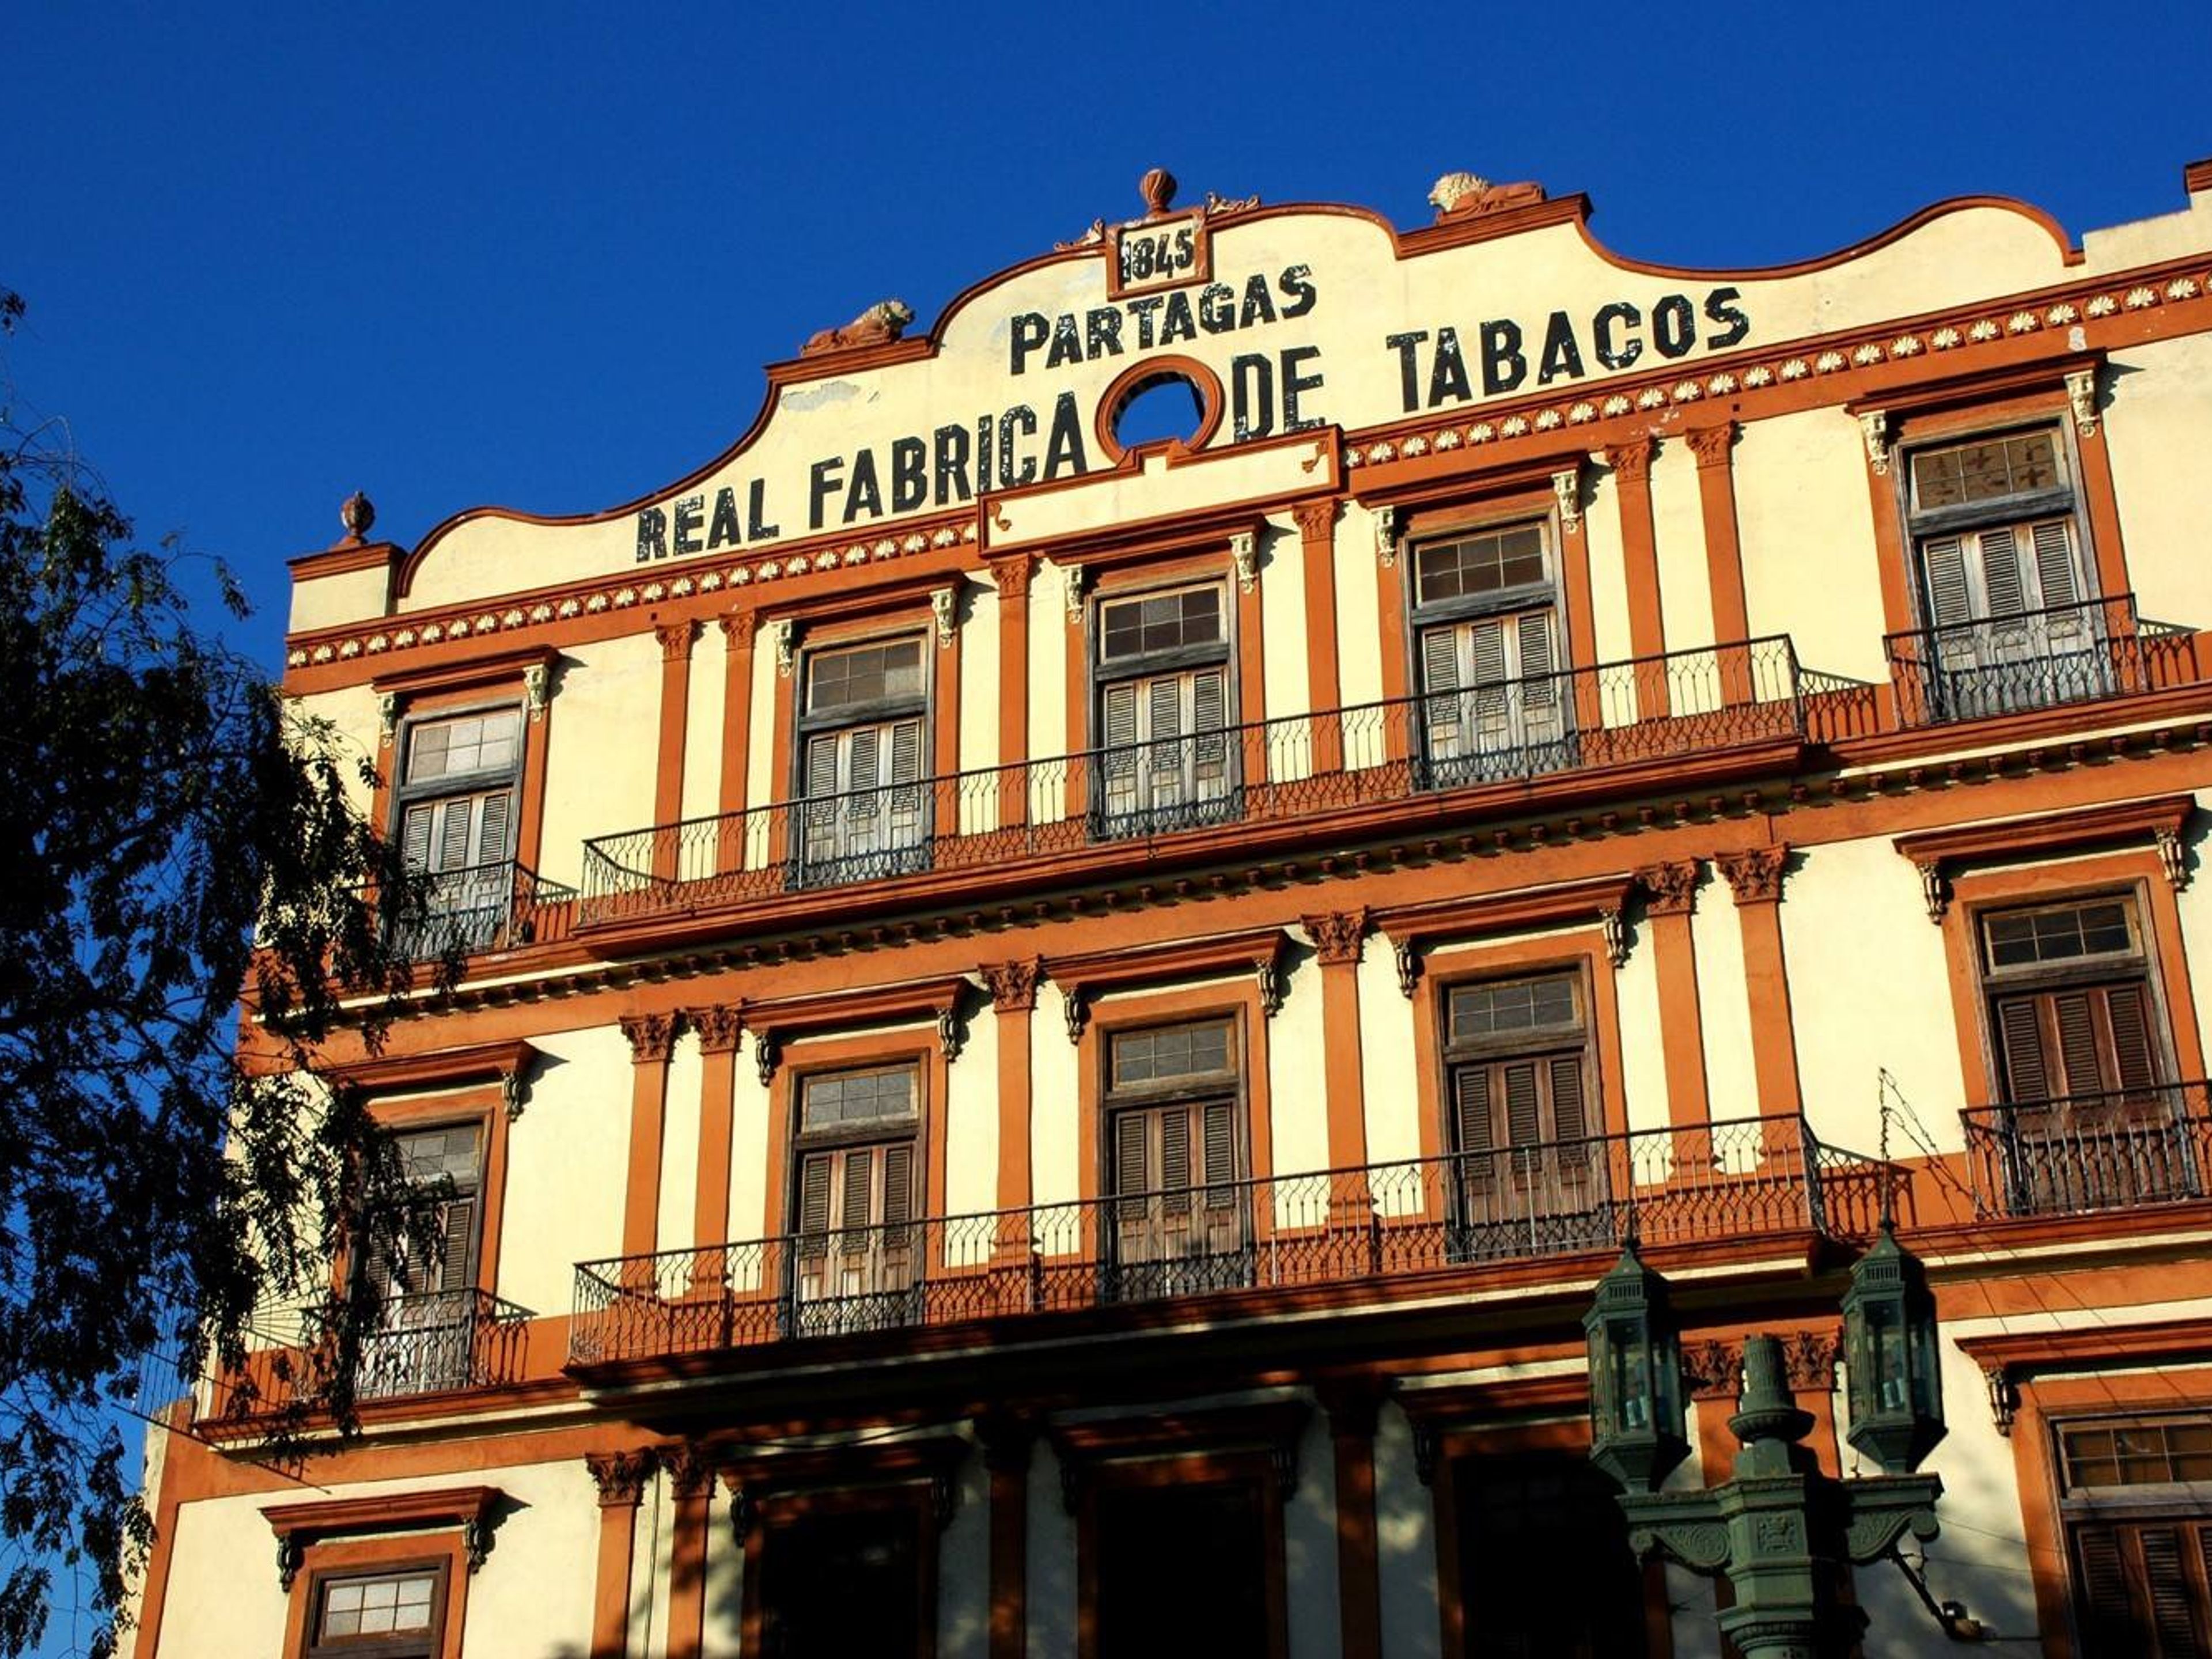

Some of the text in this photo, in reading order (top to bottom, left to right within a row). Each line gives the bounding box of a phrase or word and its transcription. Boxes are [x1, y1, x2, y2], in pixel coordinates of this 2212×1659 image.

[1120, 228, 1195, 282] 1845
[1010, 263, 1317, 376] PARTAGAS
[637, 287, 1750, 563] REAL FABRICA DE TABACOS
